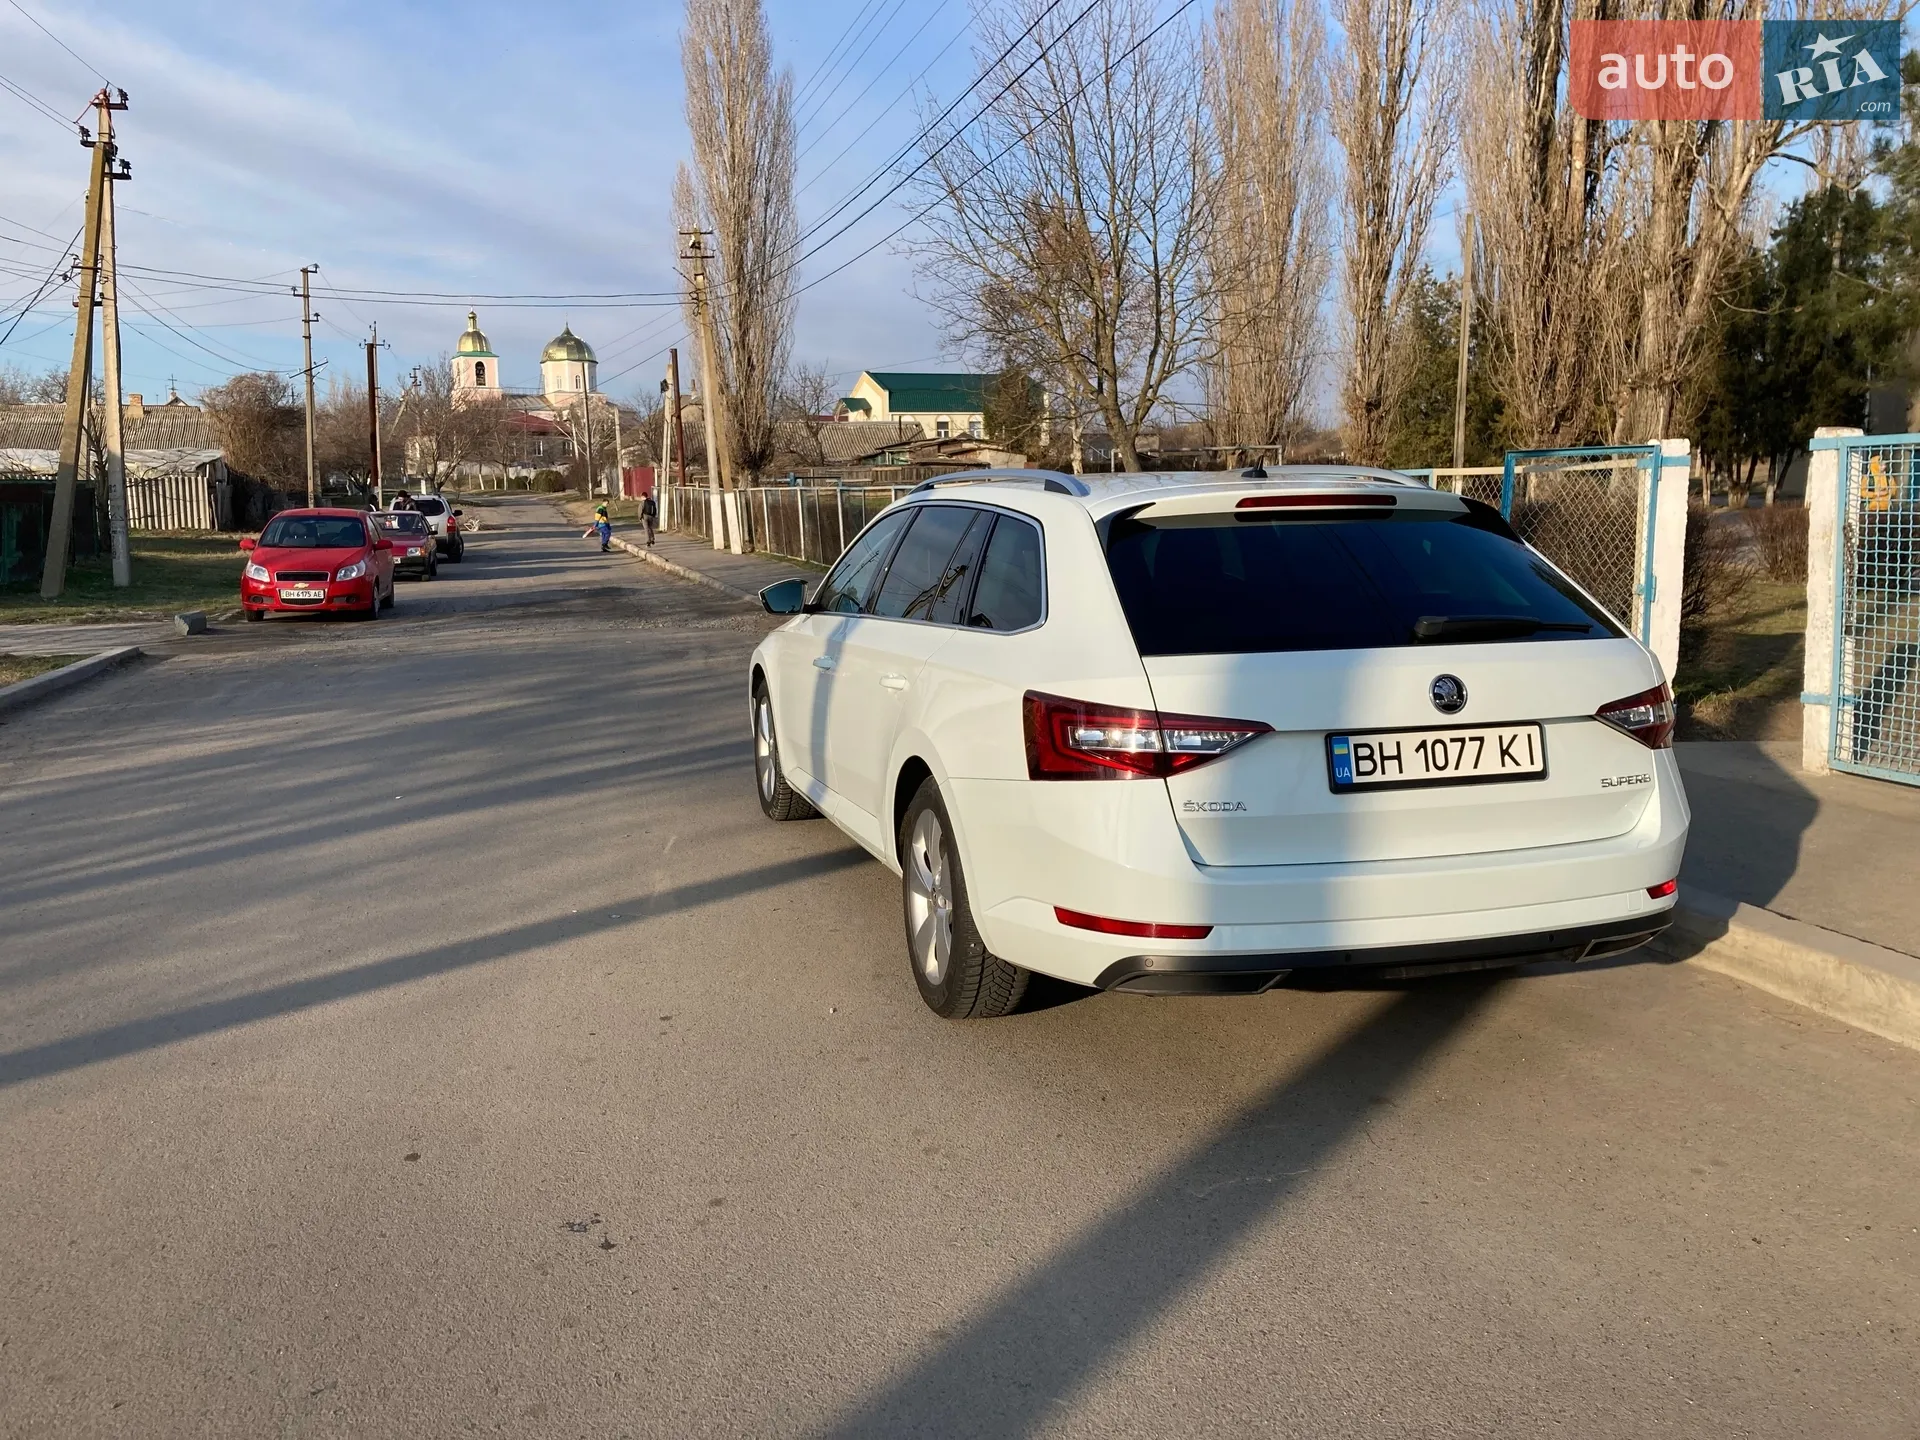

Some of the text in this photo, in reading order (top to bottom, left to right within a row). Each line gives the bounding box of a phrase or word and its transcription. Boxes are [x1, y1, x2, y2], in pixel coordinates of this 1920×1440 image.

[1352, 733, 1535, 777] BH 1077 KI
[1335, 767, 1351, 778] UA
[1601, 773, 1651, 788] SUPERB
[1183, 800, 1247, 812] ŠKODA
